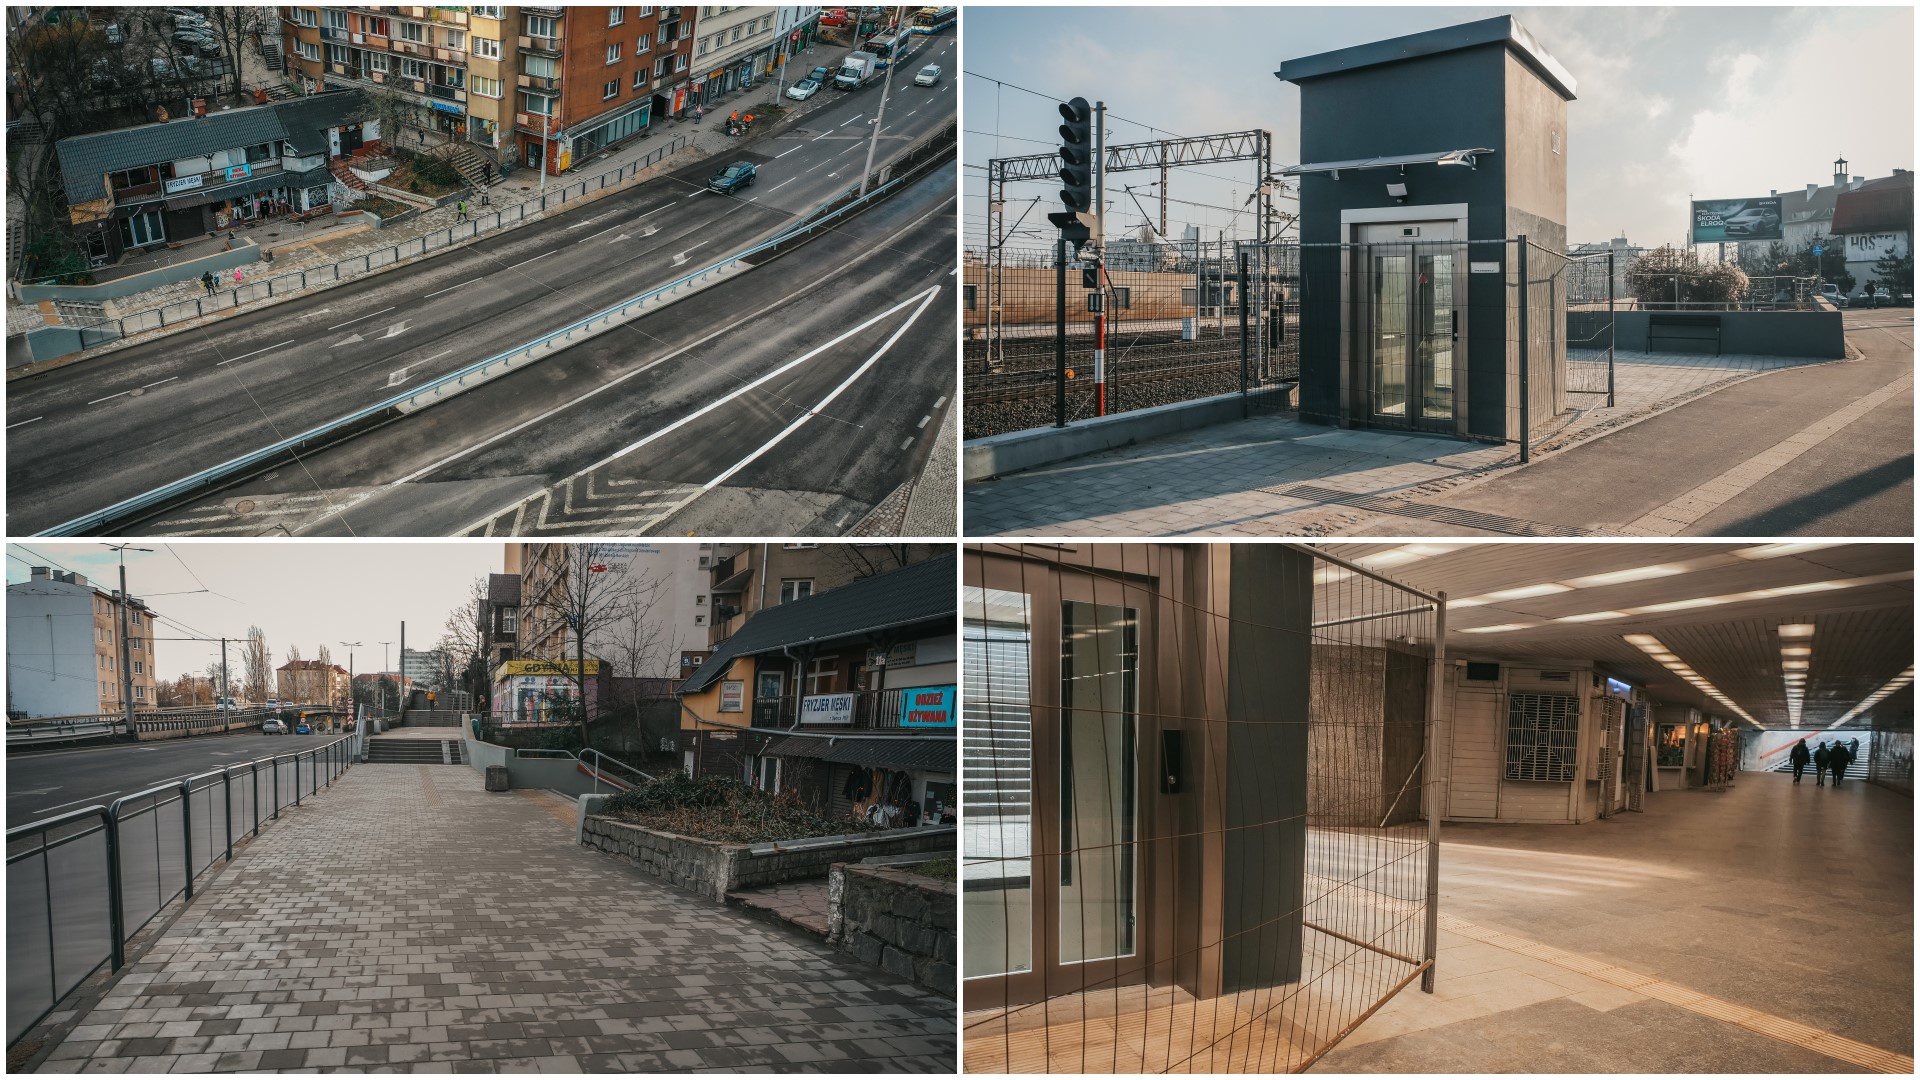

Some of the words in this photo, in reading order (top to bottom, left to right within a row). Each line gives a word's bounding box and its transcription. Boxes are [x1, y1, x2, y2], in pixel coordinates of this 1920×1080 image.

[803, 699, 830, 712] FRYZJER
[915, 691, 944, 706] ODZIEŻ
[908, 709, 947, 723] UŻYWANA
